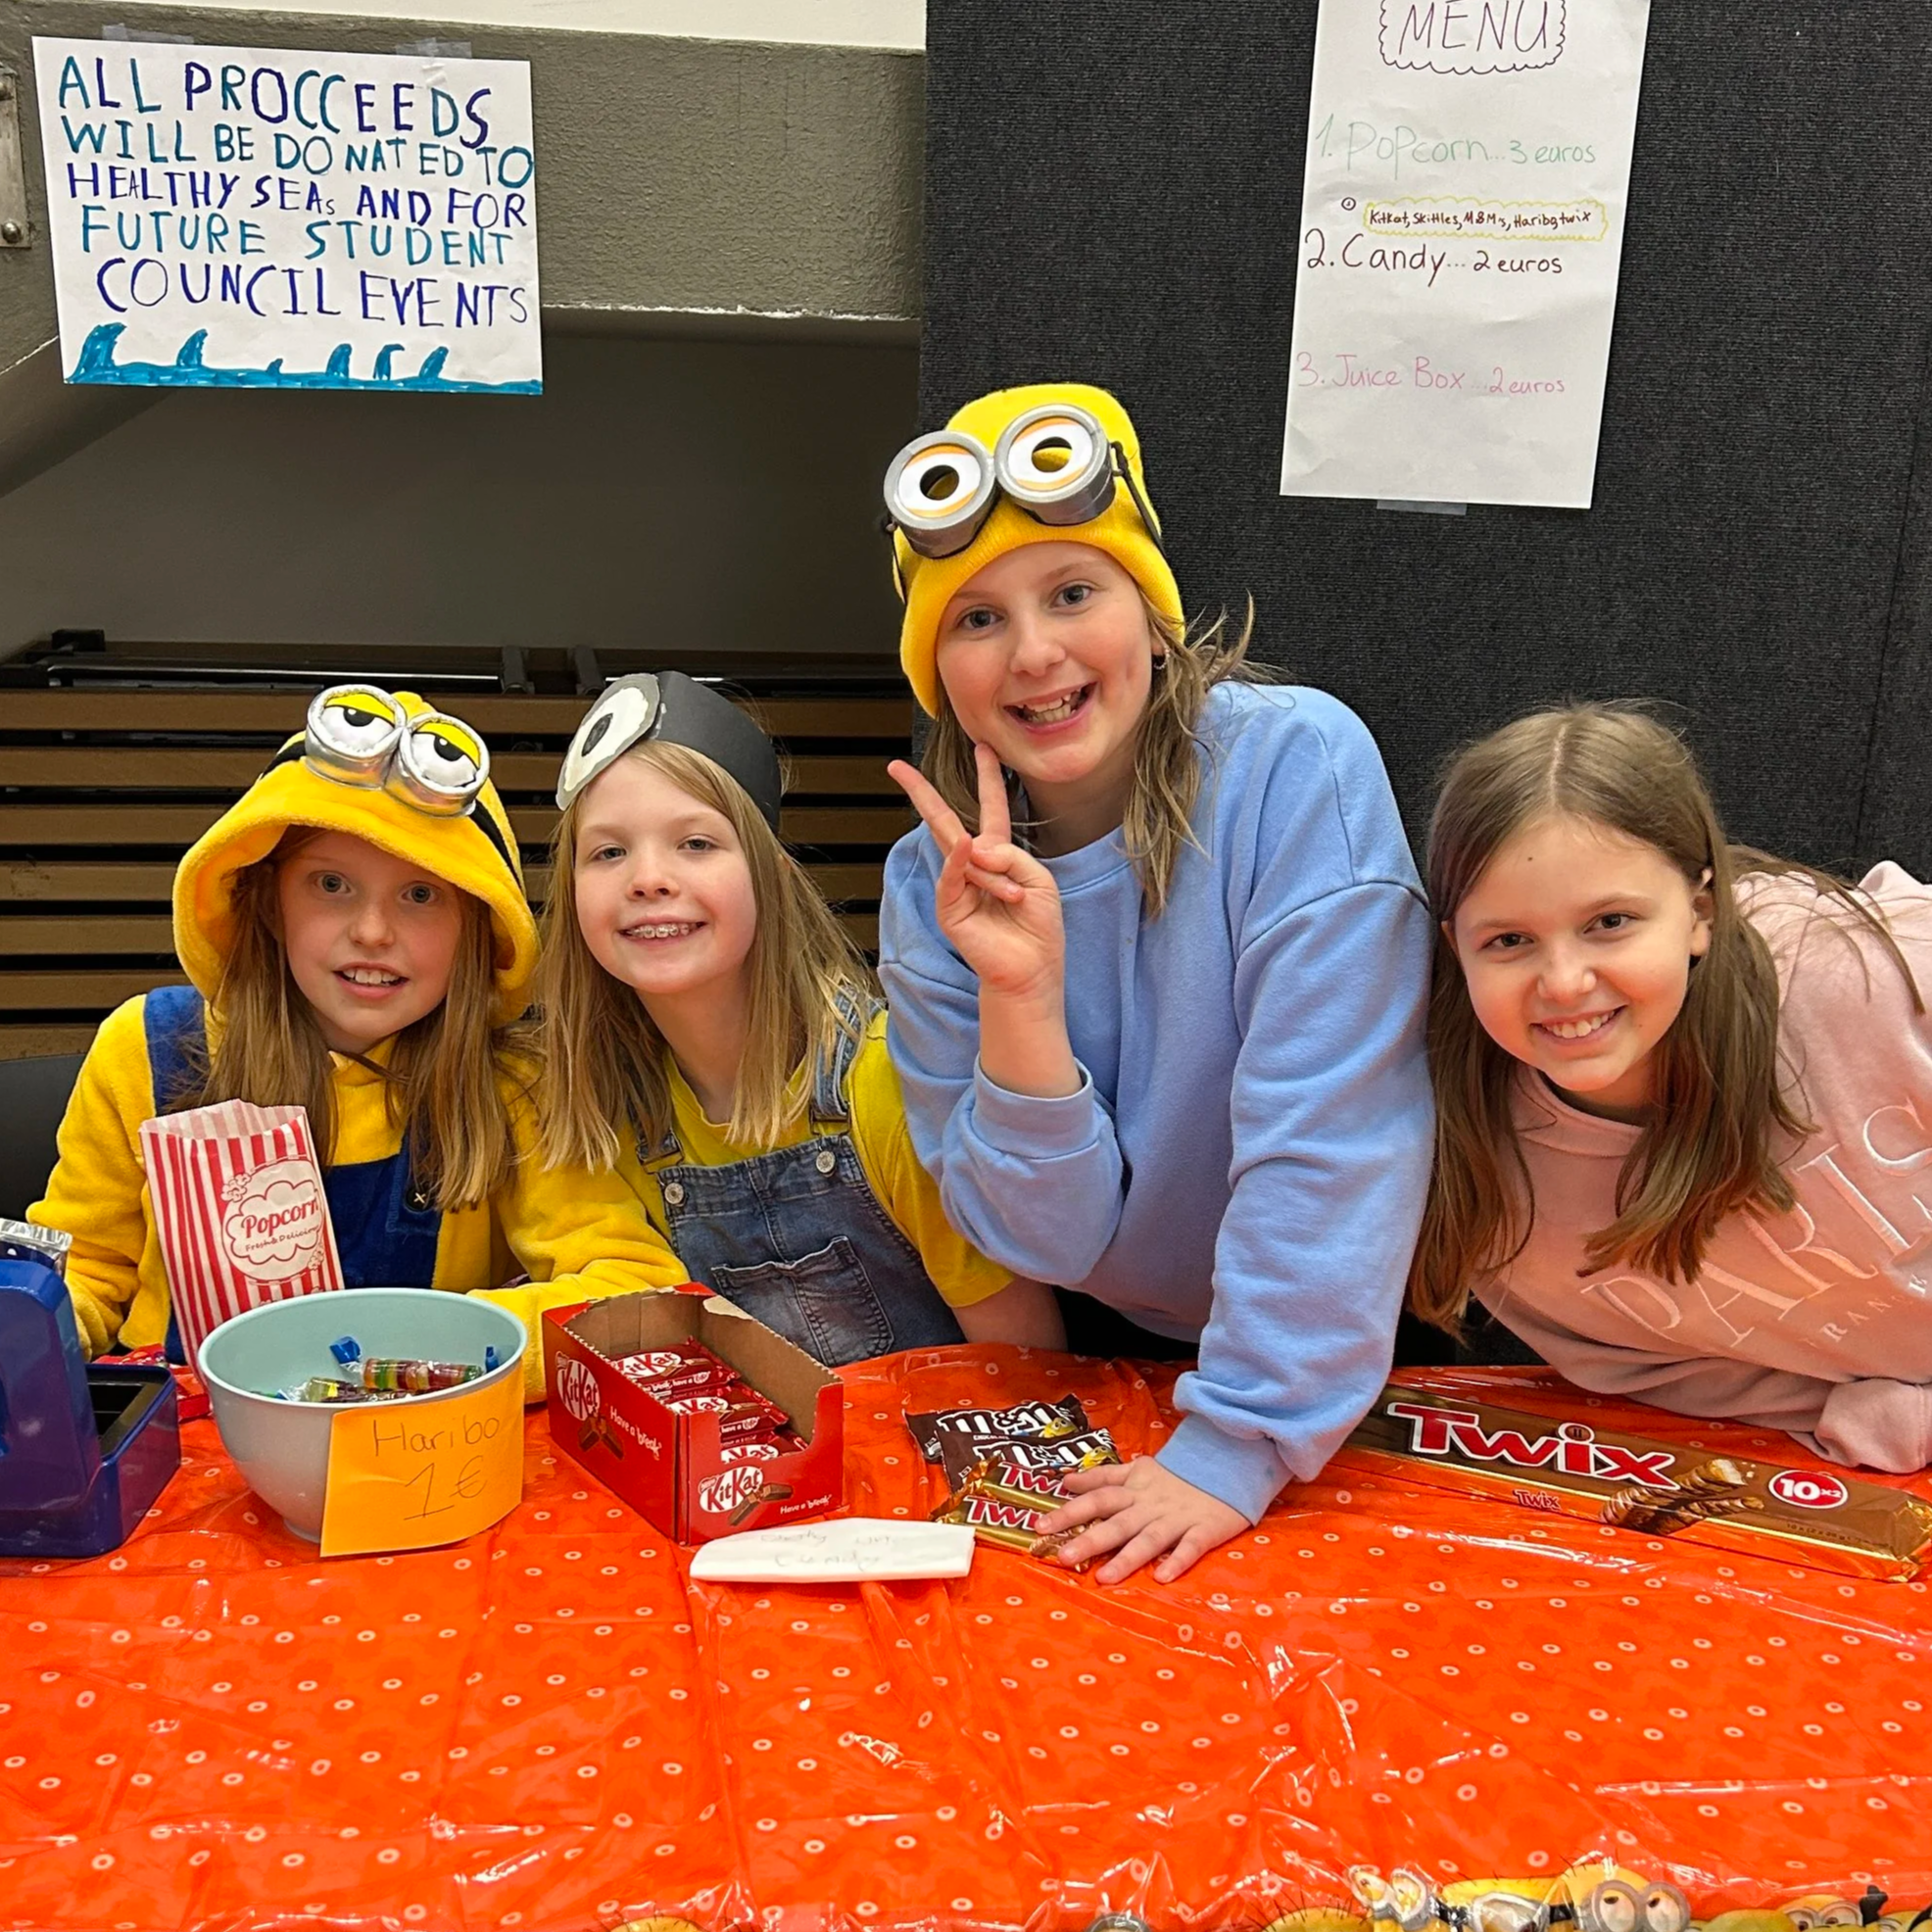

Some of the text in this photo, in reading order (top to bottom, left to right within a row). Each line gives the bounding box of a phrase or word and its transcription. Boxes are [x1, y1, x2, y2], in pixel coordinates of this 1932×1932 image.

[1399, 0, 1548, 54] MENU
[59, 56, 491, 149] ALL PROCCEEDS
[60, 116, 197, 164] WILL
[214, 123, 254, 163] BE
[475, 145, 534, 189] TO
[1510, 140, 1528, 165] 3
[1535, 144, 1596, 164] euros
[67, 163, 241, 210] HEALTHY
[357, 185, 432, 225] AND
[448, 187, 527, 229] FOR
[81, 204, 513, 267] FUTURE STUDENT
[1473, 250, 1492, 270] 2
[1498, 257, 1564, 274] euros
[96, 257, 529, 328] COUNCIL EVENTS
[1332, 354, 1403, 388] Juice
[1488, 366, 1504, 394] 2
[1510, 375, 1566, 394] euros
[241, 1197, 319, 1239] Popcorn
[560, 1360, 599, 1421] KitKat
[371, 1414, 500, 1457] Haribo
[609, 1405, 630, 1432] Have
[1386, 1403, 1681, 1490] Twix
[706, 1466, 761, 1512] KitKat
[998, 1461, 1076, 1501] Twi
[1513, 1489, 1561, 1512] Twix
[780, 1503, 799, 1516] Have
